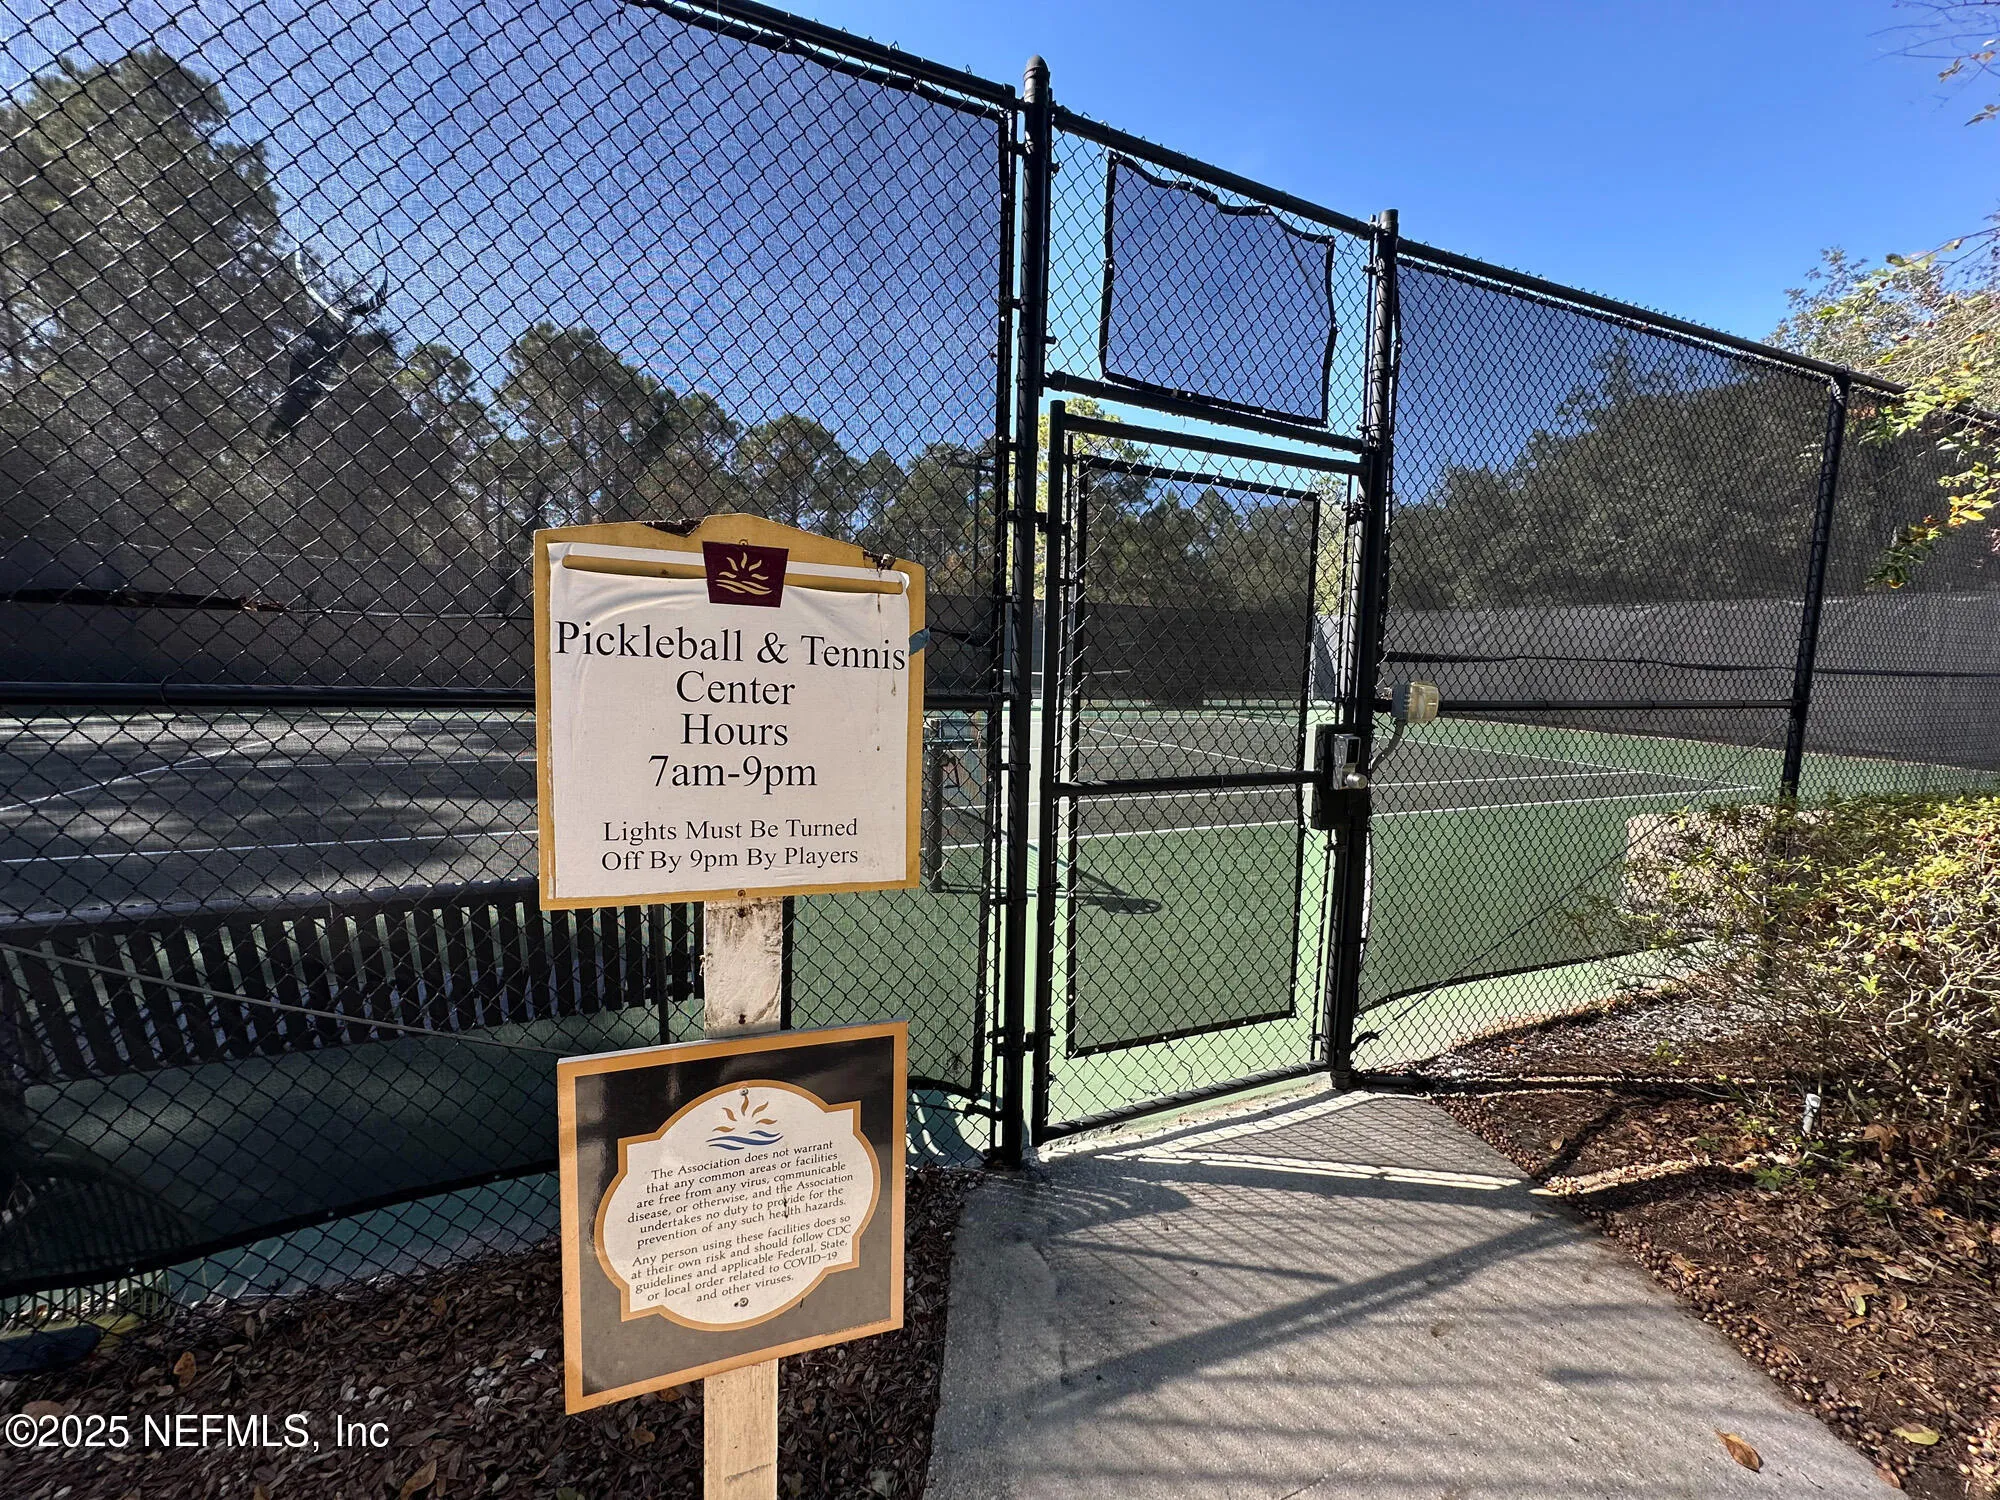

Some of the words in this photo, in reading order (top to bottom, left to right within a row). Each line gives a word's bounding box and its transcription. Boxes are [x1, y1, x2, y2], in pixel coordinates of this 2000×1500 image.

[555, 620, 742, 662] Pickleball
[757, 632, 789, 664] &
[800, 635, 905, 671] Tennis
[676, 670, 795, 705] Center
[680, 713, 789, 746] Hours
[648, 755, 817, 795] 7am-9pm
[604, 822, 677, 846] Lights
[686, 821, 742, 840] Must
[750, 820, 779, 838] Be
[785, 818, 858, 838] Turned
[602, 850, 644, 871] Off
[650, 851, 681, 873] By
[690, 850, 738, 872] 9pm
[747, 848, 776, 869] By
[785, 847, 858, 867] Players
[646, 1182, 668, 1194] that
[674, 1177, 693, 1192] any
[699, 1168, 745, 1184] common
[749, 1164, 776, 1175] areas
[780, 1160, 791, 1169] or
[796, 1153, 837, 1166] facilities
[651, 1169, 673, 1180] The
[678, 1157, 740, 1175] Association
[745, 1152, 768, 1162] does
[773, 1148, 789, 1158] not
[793, 1141, 833, 1155] warrant
[627, 1208, 671, 1223] disease,
[676, 1203, 687, 1212] or
[692, 1193, 748, 1210] otherwise,
[752, 1188, 772, 1199] and
[776, 1182, 792, 1193] the
[796, 1173, 853, 1190] Association
[636, 1198, 654, 1208] are
[659, 1192, 681, 1205] free
[685, 1186, 712, 1200] from
[716, 1184, 736, 1195] any
[741, 1177, 770, 1188] virus,
[774, 1163, 845, 1182] communicable
[637, 1230, 697, 1249] prevention
[701, 1223, 713, 1232] of
[717, 1219, 736, 1231] any
[741, 1214, 764, 1225] such
[769, 1207, 800, 1220] health
[805, 1200, 846, 1212] hazards.
[640, 1215, 701, 1234] undertakes
[706, 1210, 720, 1219] no
[724, 1204, 748, 1218] duty
[752, 1202, 763, 1210] to
[767, 1193, 805, 1210] provide
[809, 1190, 823, 1200] for
[827, 1186, 843, 1196] the
[631, 1254, 657, 1267] Any
[661, 1247, 698, 1263] person
[702, 1240, 732, 1252] using
[736, 1232, 763, 1245] these
[767, 1223, 810, 1238] facilities
[814, 1217, 836, 1227] does
[631, 1271, 642, 1280] at
[646, 1263, 673, 1276] their
[678, 1260, 701, 1269] own
[706, 1253, 726, 1264] risk
[730, 1246, 750, 1258] and
[754, 1238, 788, 1253] should
[792, 1232, 822, 1244] follow
[827, 1224, 851, 1237] CDC
[635, 1275, 692, 1294] guidelines
[697, 1268, 717, 1279] and
[721, 1256, 774, 1275] applicable
[778, 1245, 817, 1259] Federal,
[821, 1240, 848, 1250] State,
[648, 1292, 660, 1301] or
[664, 1284, 690, 1297] local
[695, 1278, 724, 1290] order
[729, 1270, 765, 1283] related
[769, 1265, 779, 1273] to
[696, 1291, 717, 1302] and
[721, 1283, 750, 1297] other
[755, 1277, 793, 1289] viruses.
